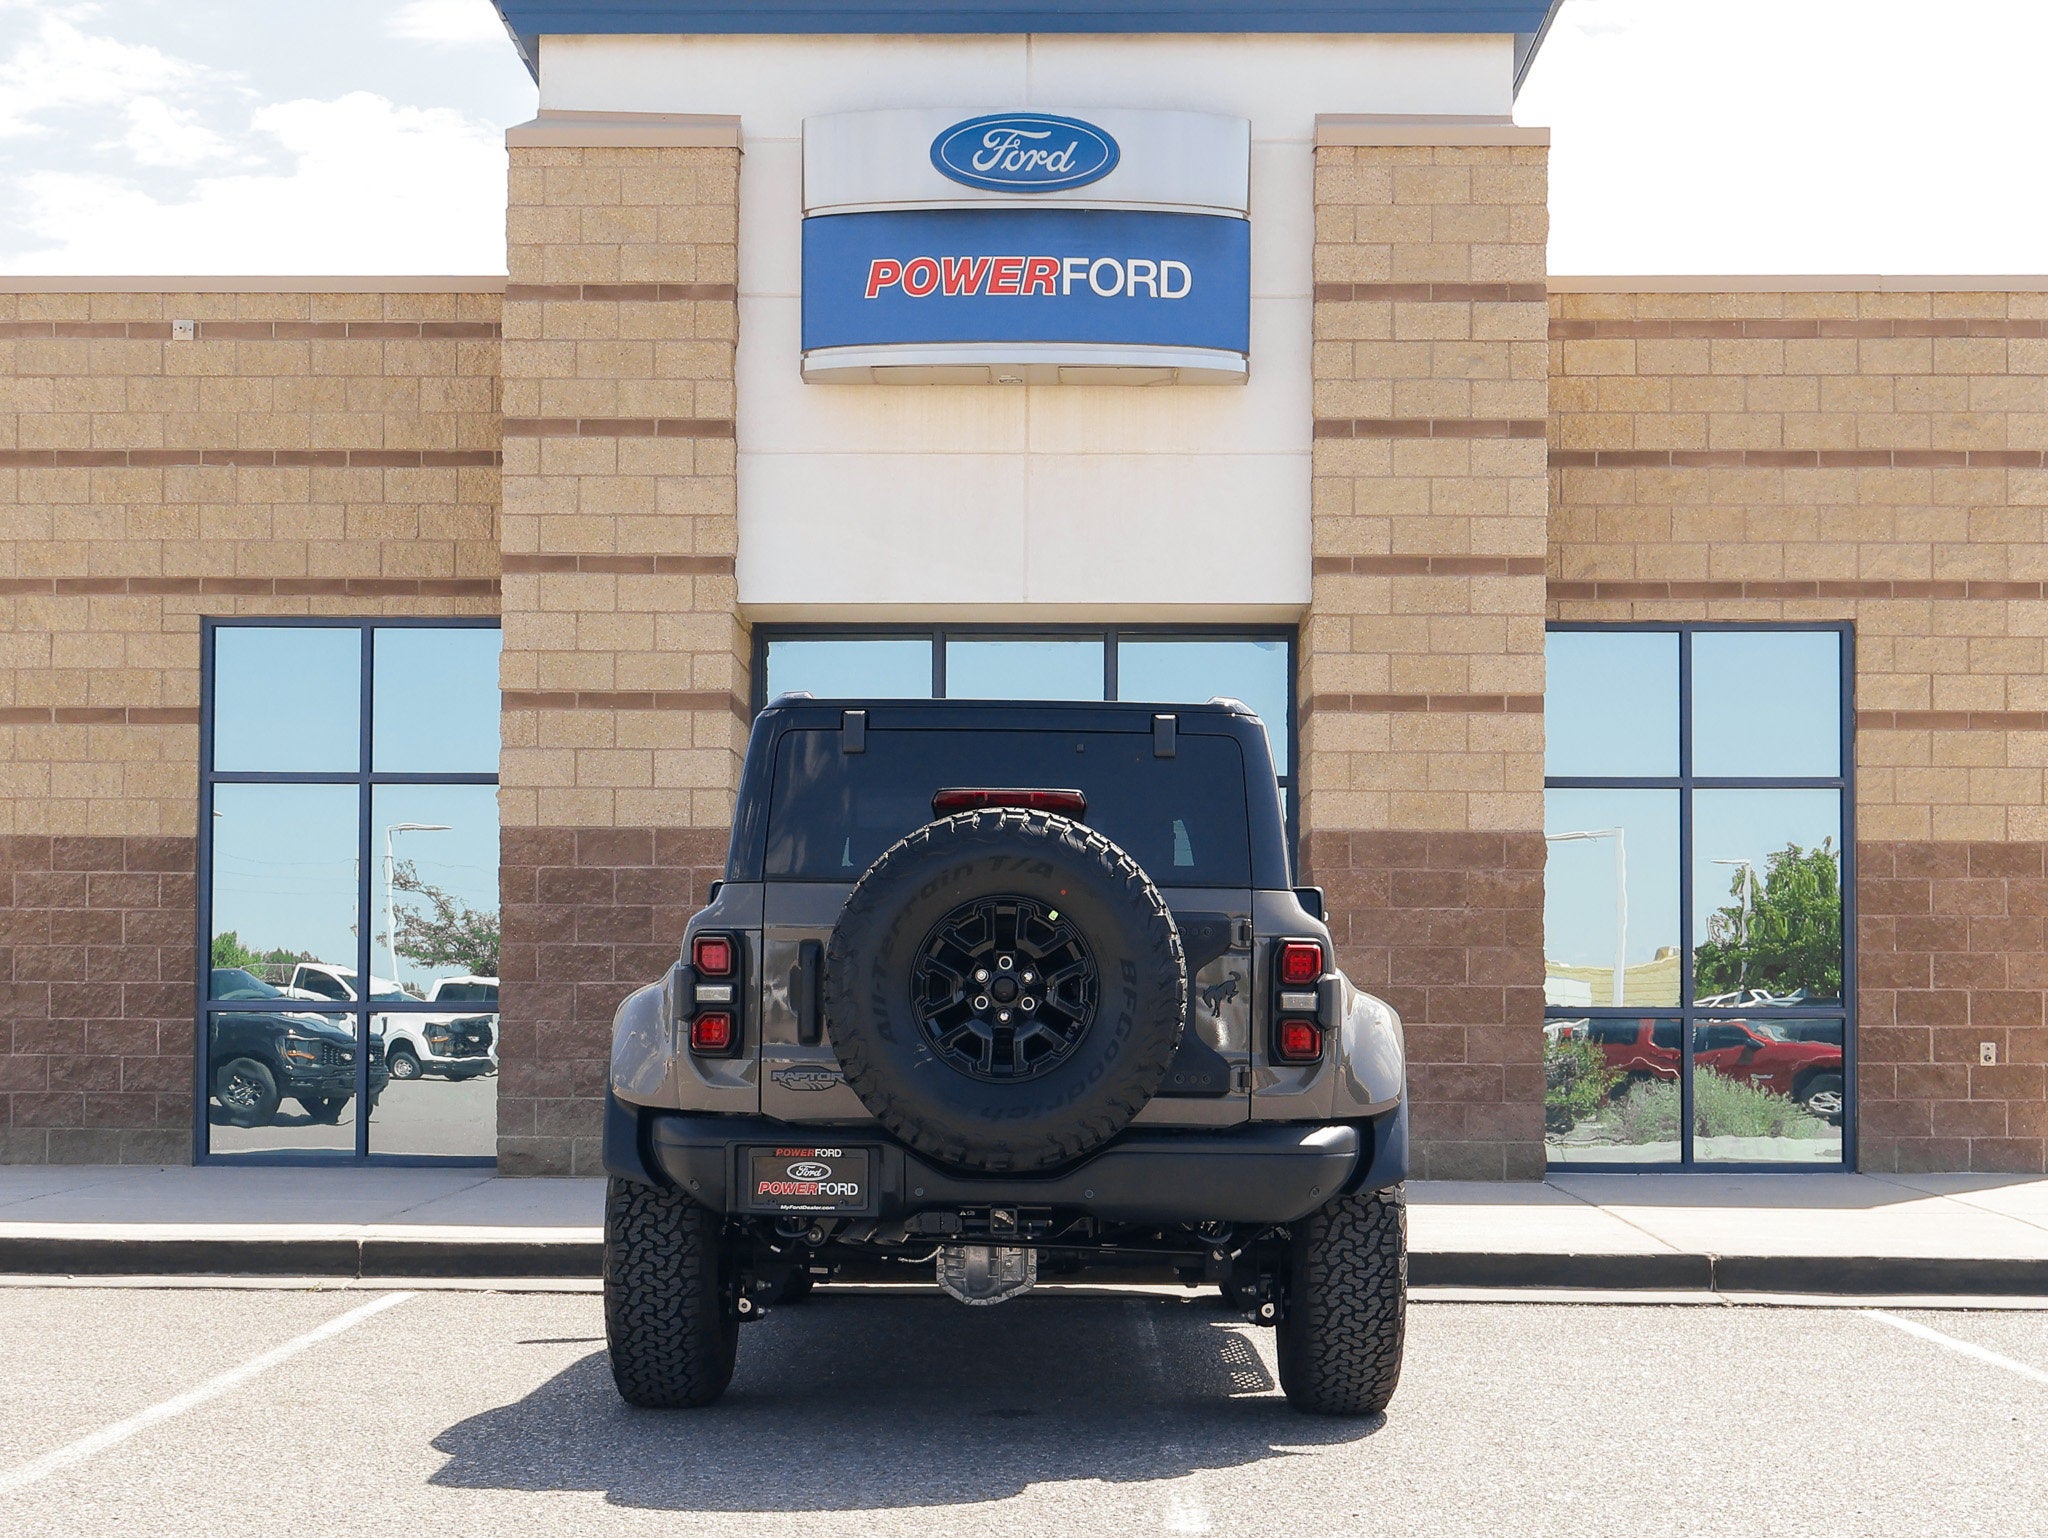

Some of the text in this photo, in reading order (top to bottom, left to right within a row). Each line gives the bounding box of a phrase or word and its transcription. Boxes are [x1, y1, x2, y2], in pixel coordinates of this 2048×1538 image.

[973, 128, 1078, 173] Ford
[989, 855, 1054, 879] T/A
[771, 1071, 844, 1082] RAPTOR
[776, 1149, 841, 1157] POWERFORD
[796, 1166, 823, 1177] Ford
[758, 1182, 858, 1195] POWERFORD
